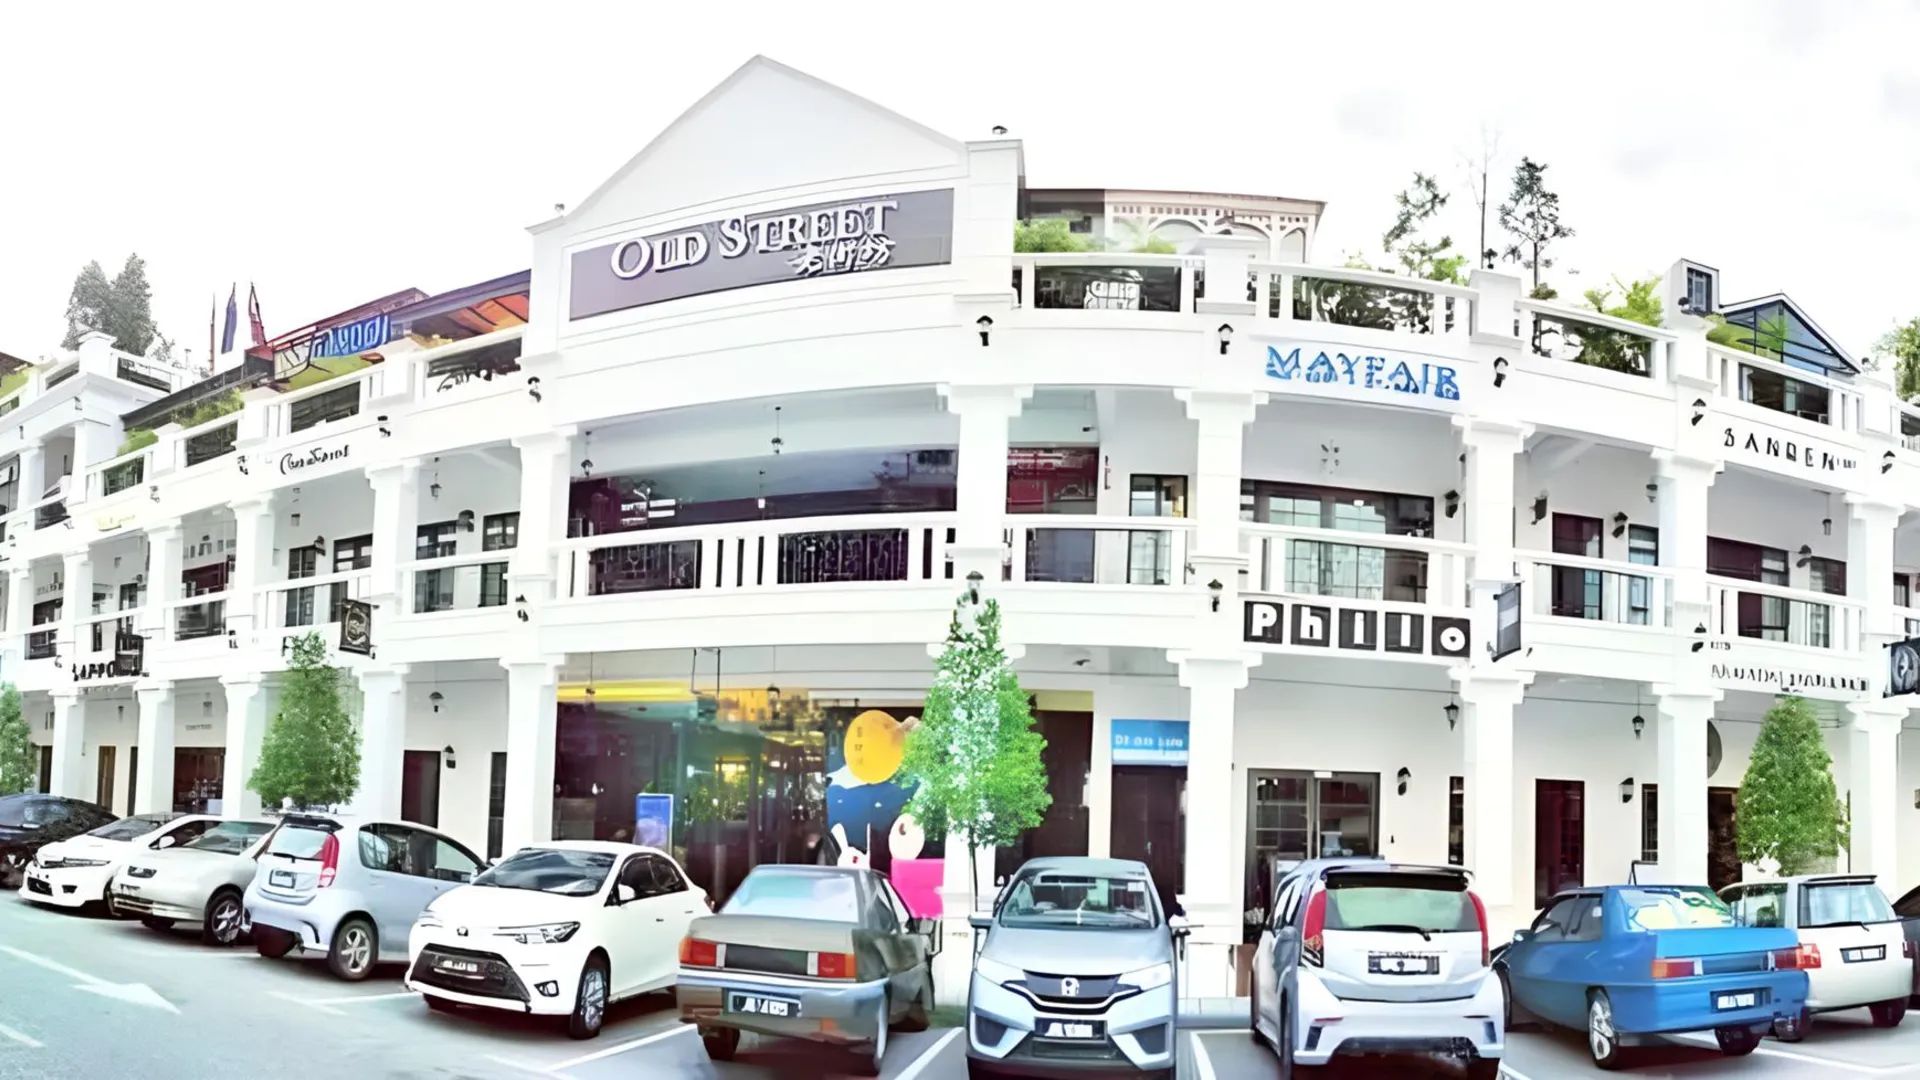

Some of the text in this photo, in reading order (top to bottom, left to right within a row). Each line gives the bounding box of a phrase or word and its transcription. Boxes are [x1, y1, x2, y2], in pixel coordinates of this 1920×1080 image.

[610, 231, 710, 279] OLD
[719, 200, 898, 259] STREET
[1265, 345, 1460, 401] MAYFAIR
